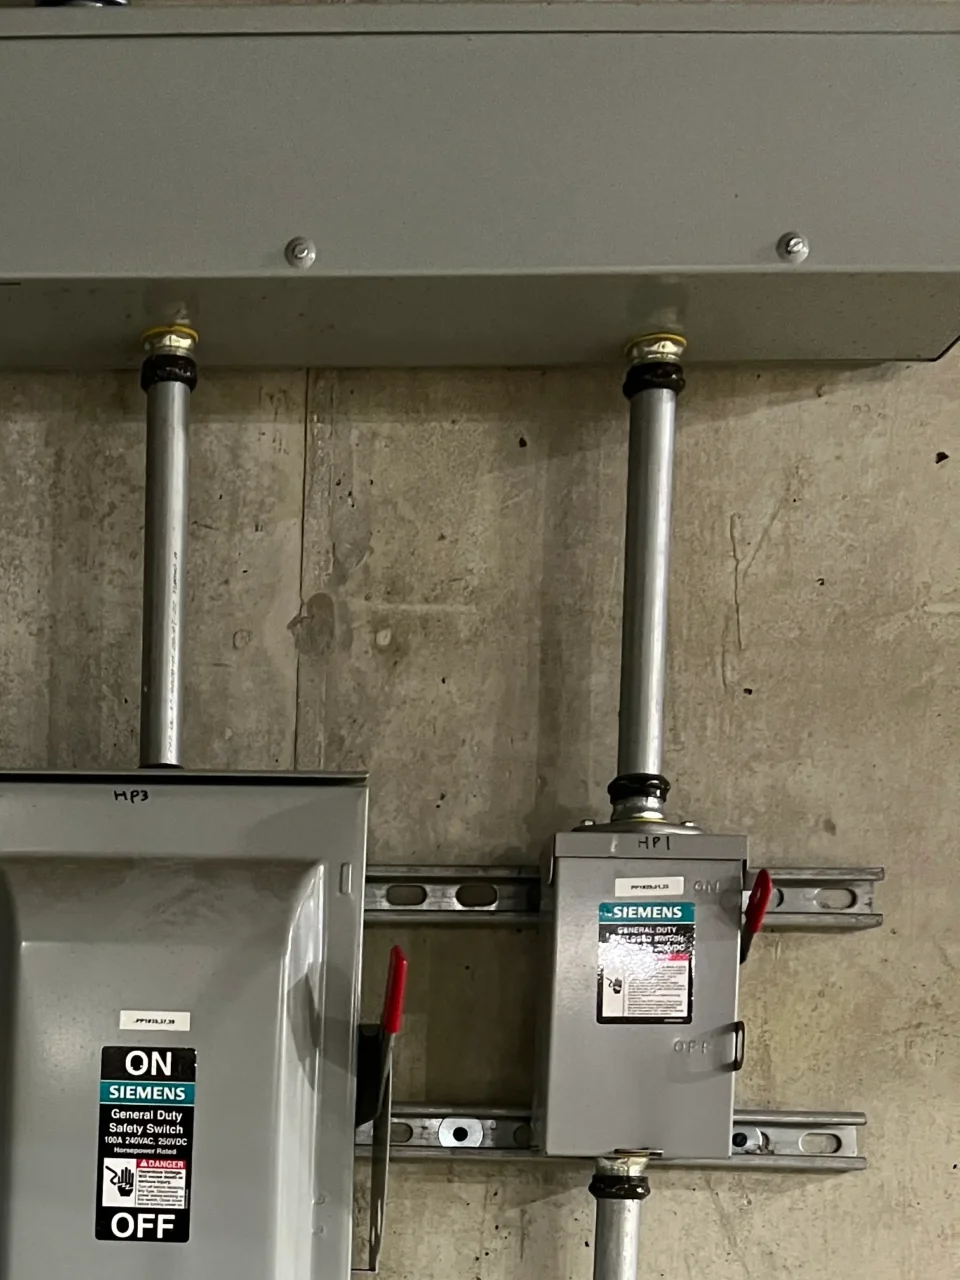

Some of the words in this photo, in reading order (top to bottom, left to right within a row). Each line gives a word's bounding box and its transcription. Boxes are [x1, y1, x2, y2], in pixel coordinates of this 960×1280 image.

[113, 789, 149, 804] HP3
[613, 906, 683, 919] SIEMENS
[617, 926, 655, 934] GENERAL
[655, 926, 678, 934] DUTY
[125, 1050, 172, 1076] ON
[109, 1085, 186, 1100] SIEMENS
[110, 1108, 154, 1119] General
[157, 1109, 183, 1123] Duty
[108, 1122, 144, 1135] Safety
[146, 1123, 184, 1134] Switch
[104, 1136, 123, 1144] 100A
[157, 1137, 188, 1146] 250VDC
[113, 1146, 155, 1155] Horsepower
[156, 1147, 177, 1155] Rated
[148, 1159, 184, 1168] DANGER
[111, 1212, 176, 1239] OFF
